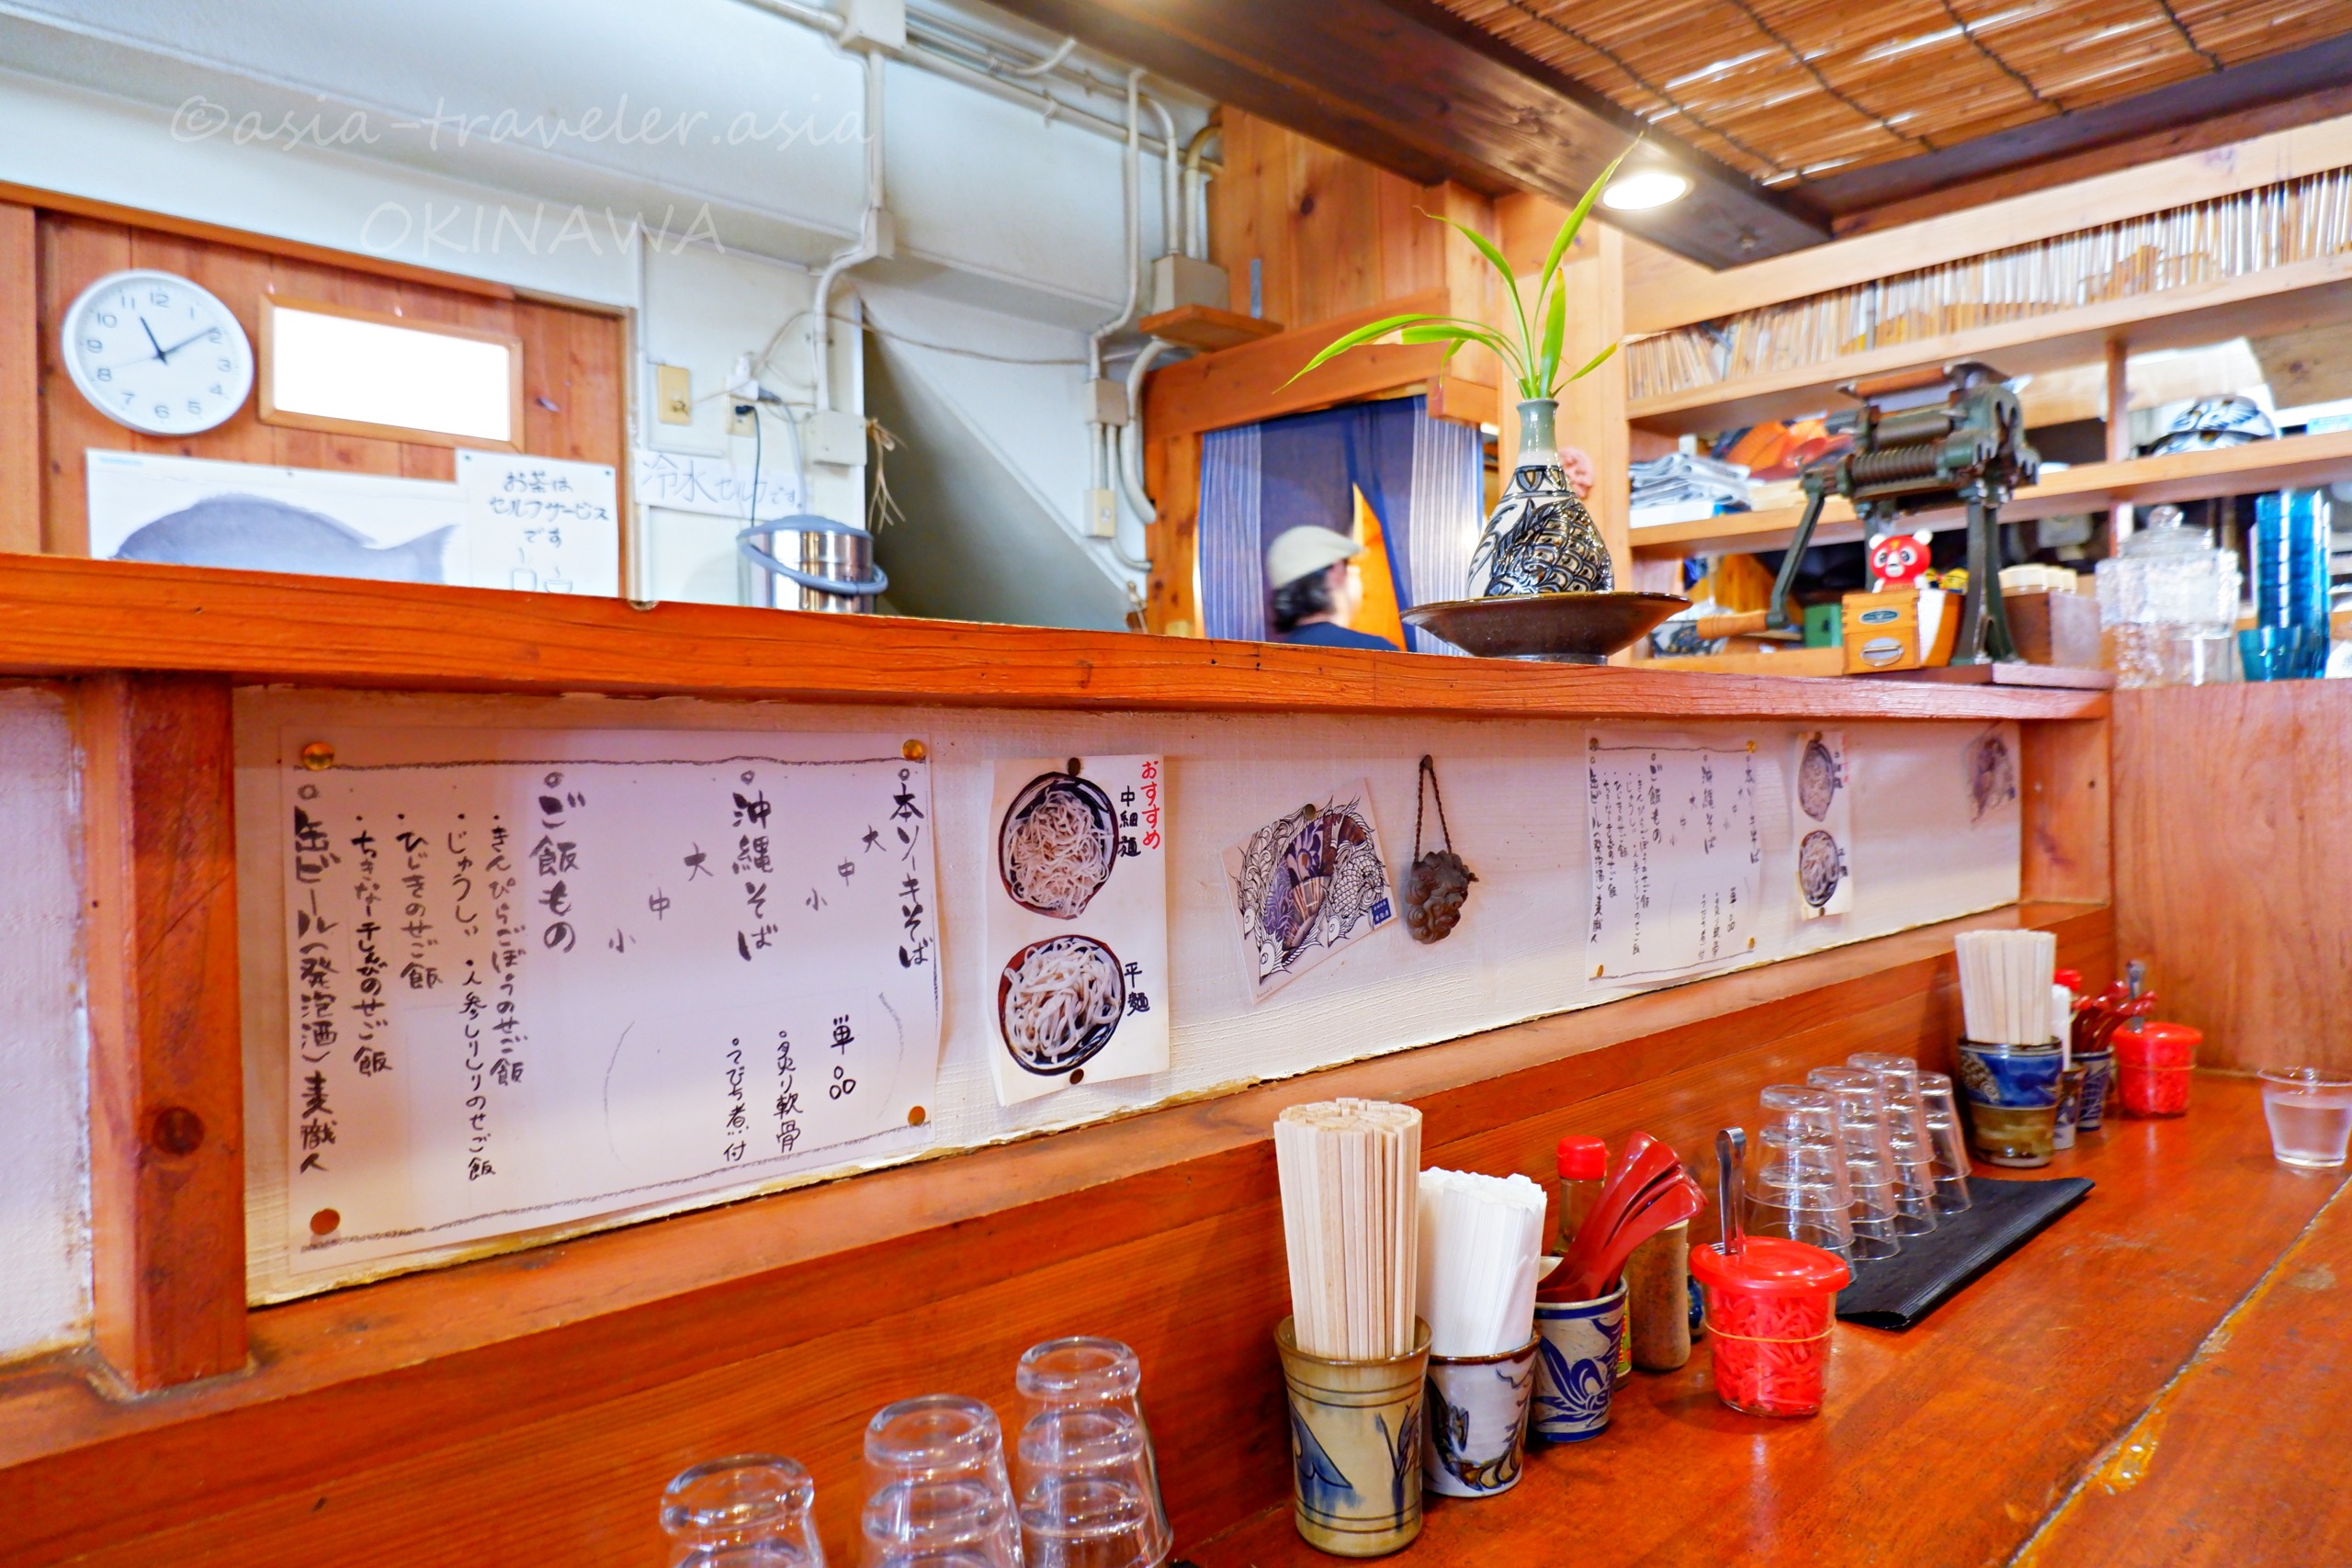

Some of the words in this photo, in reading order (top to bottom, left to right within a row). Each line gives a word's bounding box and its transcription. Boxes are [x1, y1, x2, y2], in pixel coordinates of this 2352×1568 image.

[120, 295, 136, 310] 11
[150, 292, 169, 309] 12
[96, 312, 118, 329] 10
[189, 308, 195, 320] 1
[87, 339, 103, 353] 9
[96, 368, 111, 382] 8
[218, 359, 231, 372] 3
[121, 391, 135, 405] 7
[209, 384, 222, 395] 4
[154, 405, 169, 419] 6
[187, 400, 201, 414] 5
[503, 469, 573, 493] お茶は
[489, 497, 609, 522] セルフサービス
[524, 527, 562, 547] です
[1140, 761, 1161, 850] おすすめ
[863, 825, 887, 852] 大
[530, 794, 585, 953] ご飯もの
[683, 842, 713, 881] 大
[838, 856, 855, 886] 中
[732, 790, 779, 961] 沖縄そば
[889, 783, 933, 969] 本ソーキそば
[396, 831, 443, 989] ひじきのせご飯
[649, 887, 670, 920] 中
[806, 887, 828, 911] 小
[609, 928, 636, 953] 小
[486, 827, 528, 1086] きんぴらごぼうのせご飯
[830, 1014, 856, 1100] 単品
